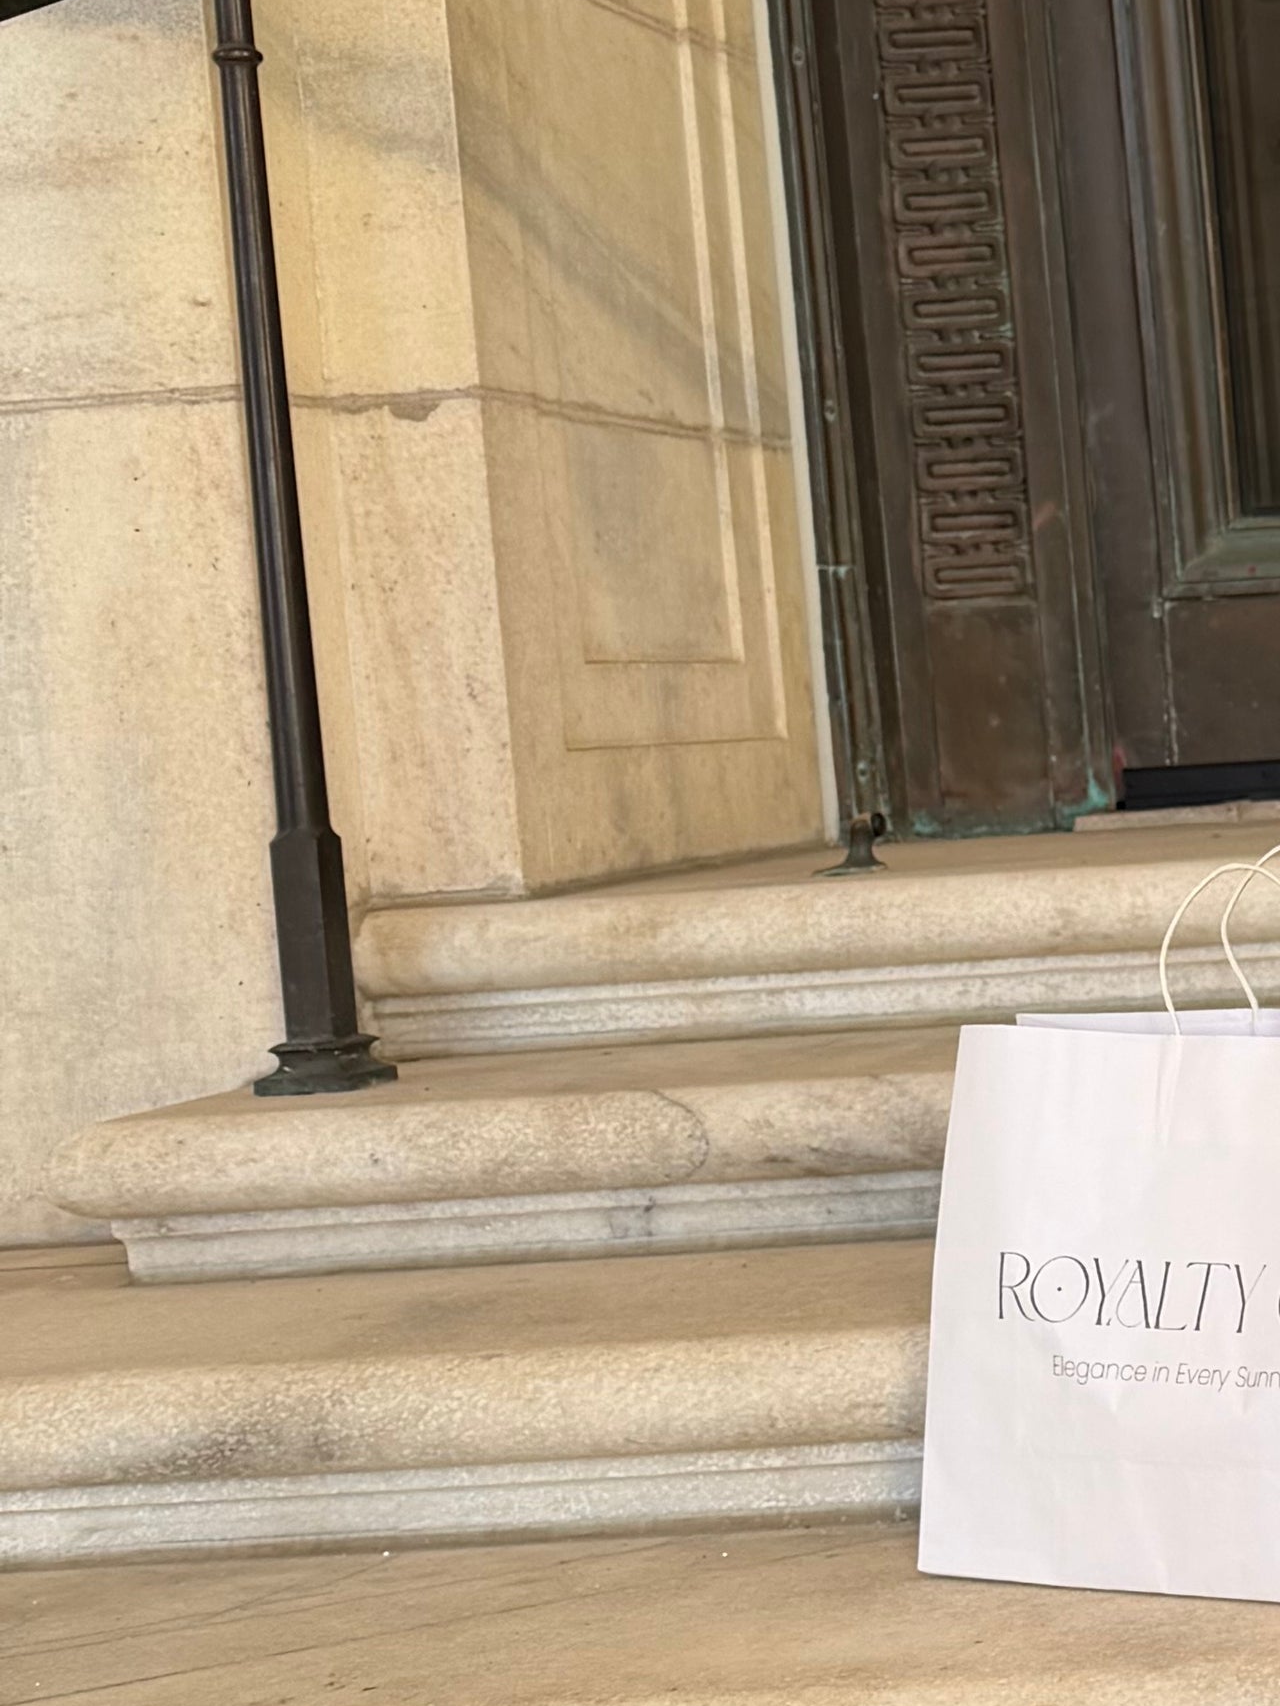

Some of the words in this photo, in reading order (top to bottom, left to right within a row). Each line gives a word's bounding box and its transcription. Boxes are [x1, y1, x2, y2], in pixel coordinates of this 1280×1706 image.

[998, 1250, 1268, 1335] ROYALTY
[1051, 1354, 1148, 1385] Elegance
[1151, 1360, 1170, 1383] in
[1175, 1362, 1231, 1392] Every
